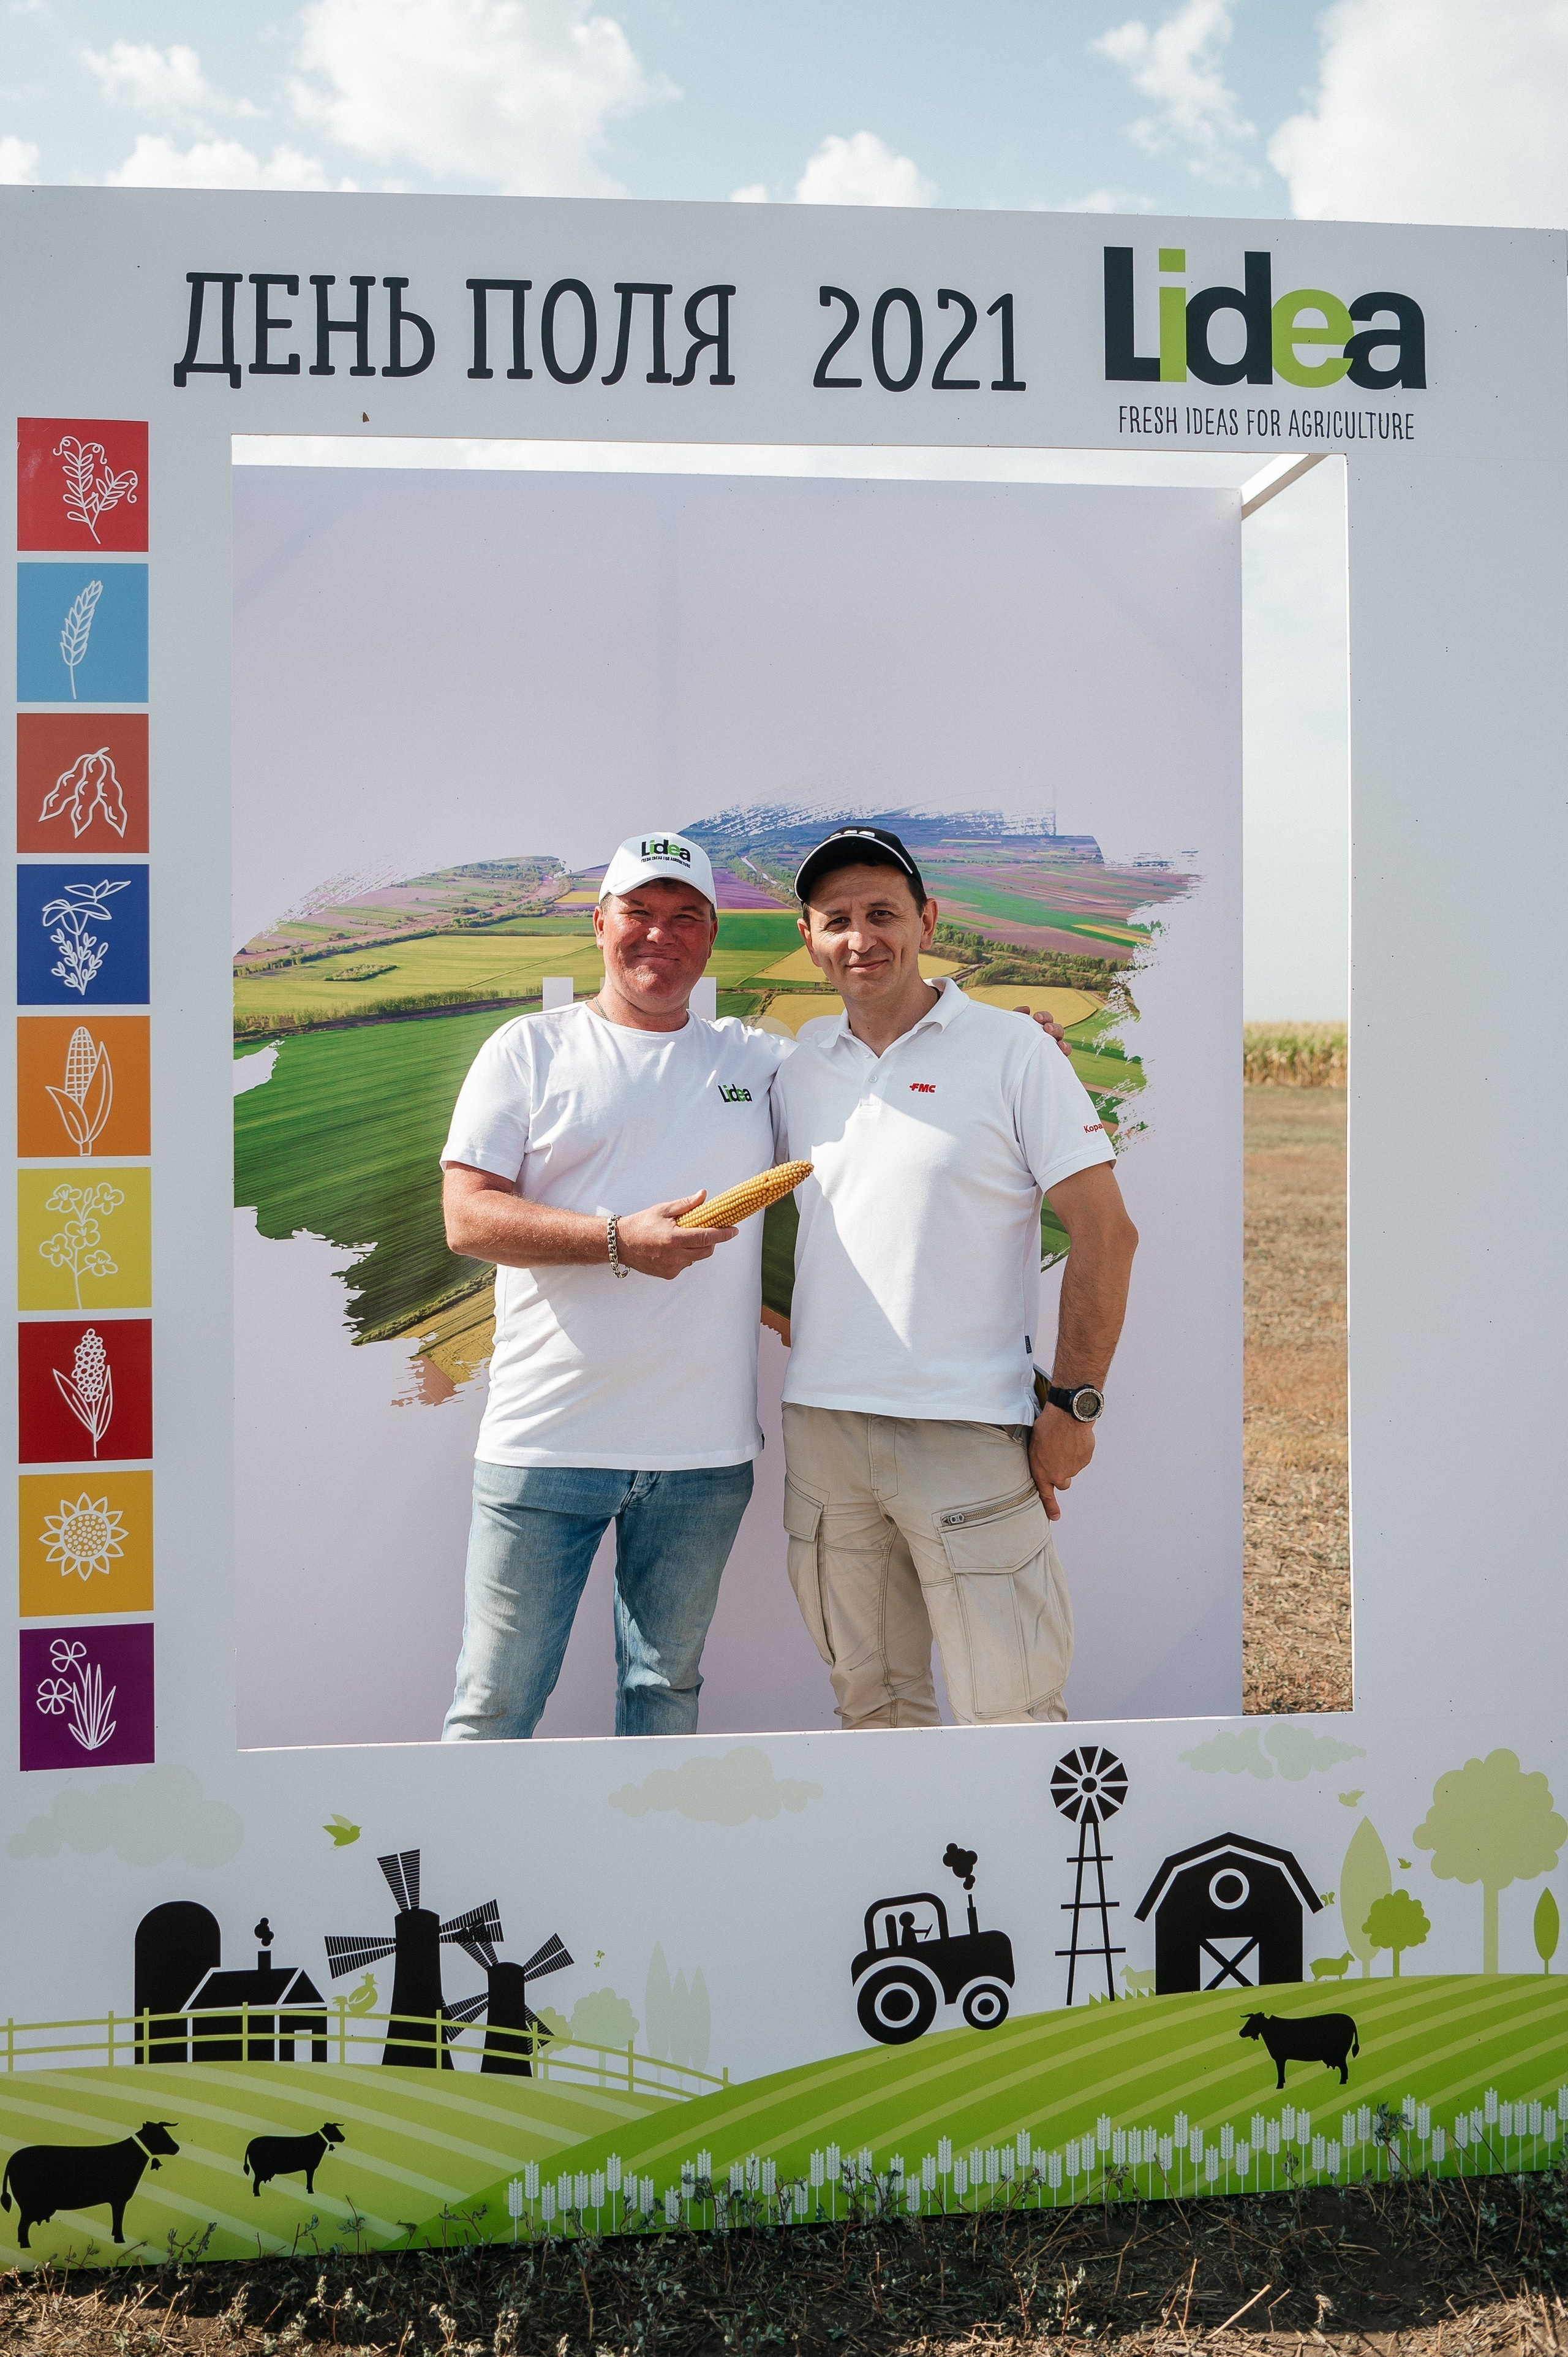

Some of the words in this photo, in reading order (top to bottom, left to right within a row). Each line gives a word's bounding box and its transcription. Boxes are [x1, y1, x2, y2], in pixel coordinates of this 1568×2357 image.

[173, 271, 436, 389] ДЕНЬ
[466, 278, 737, 387] ПОЛЯ
[812, 285, 1027, 393] 2021
[1103, 246, 1427, 390] Lidea
[1118, 406, 1177, 434] FRESH
[1186, 407, 1238, 436] IDEAS
[1246, 409, 1281, 437] FOR
[1288, 409, 1415, 441] AGRICULTURE
[641, 839, 691, 863] Lidea
[717, 1083, 753, 1103] Lidea
[910, 1083, 936, 1093] FMC
